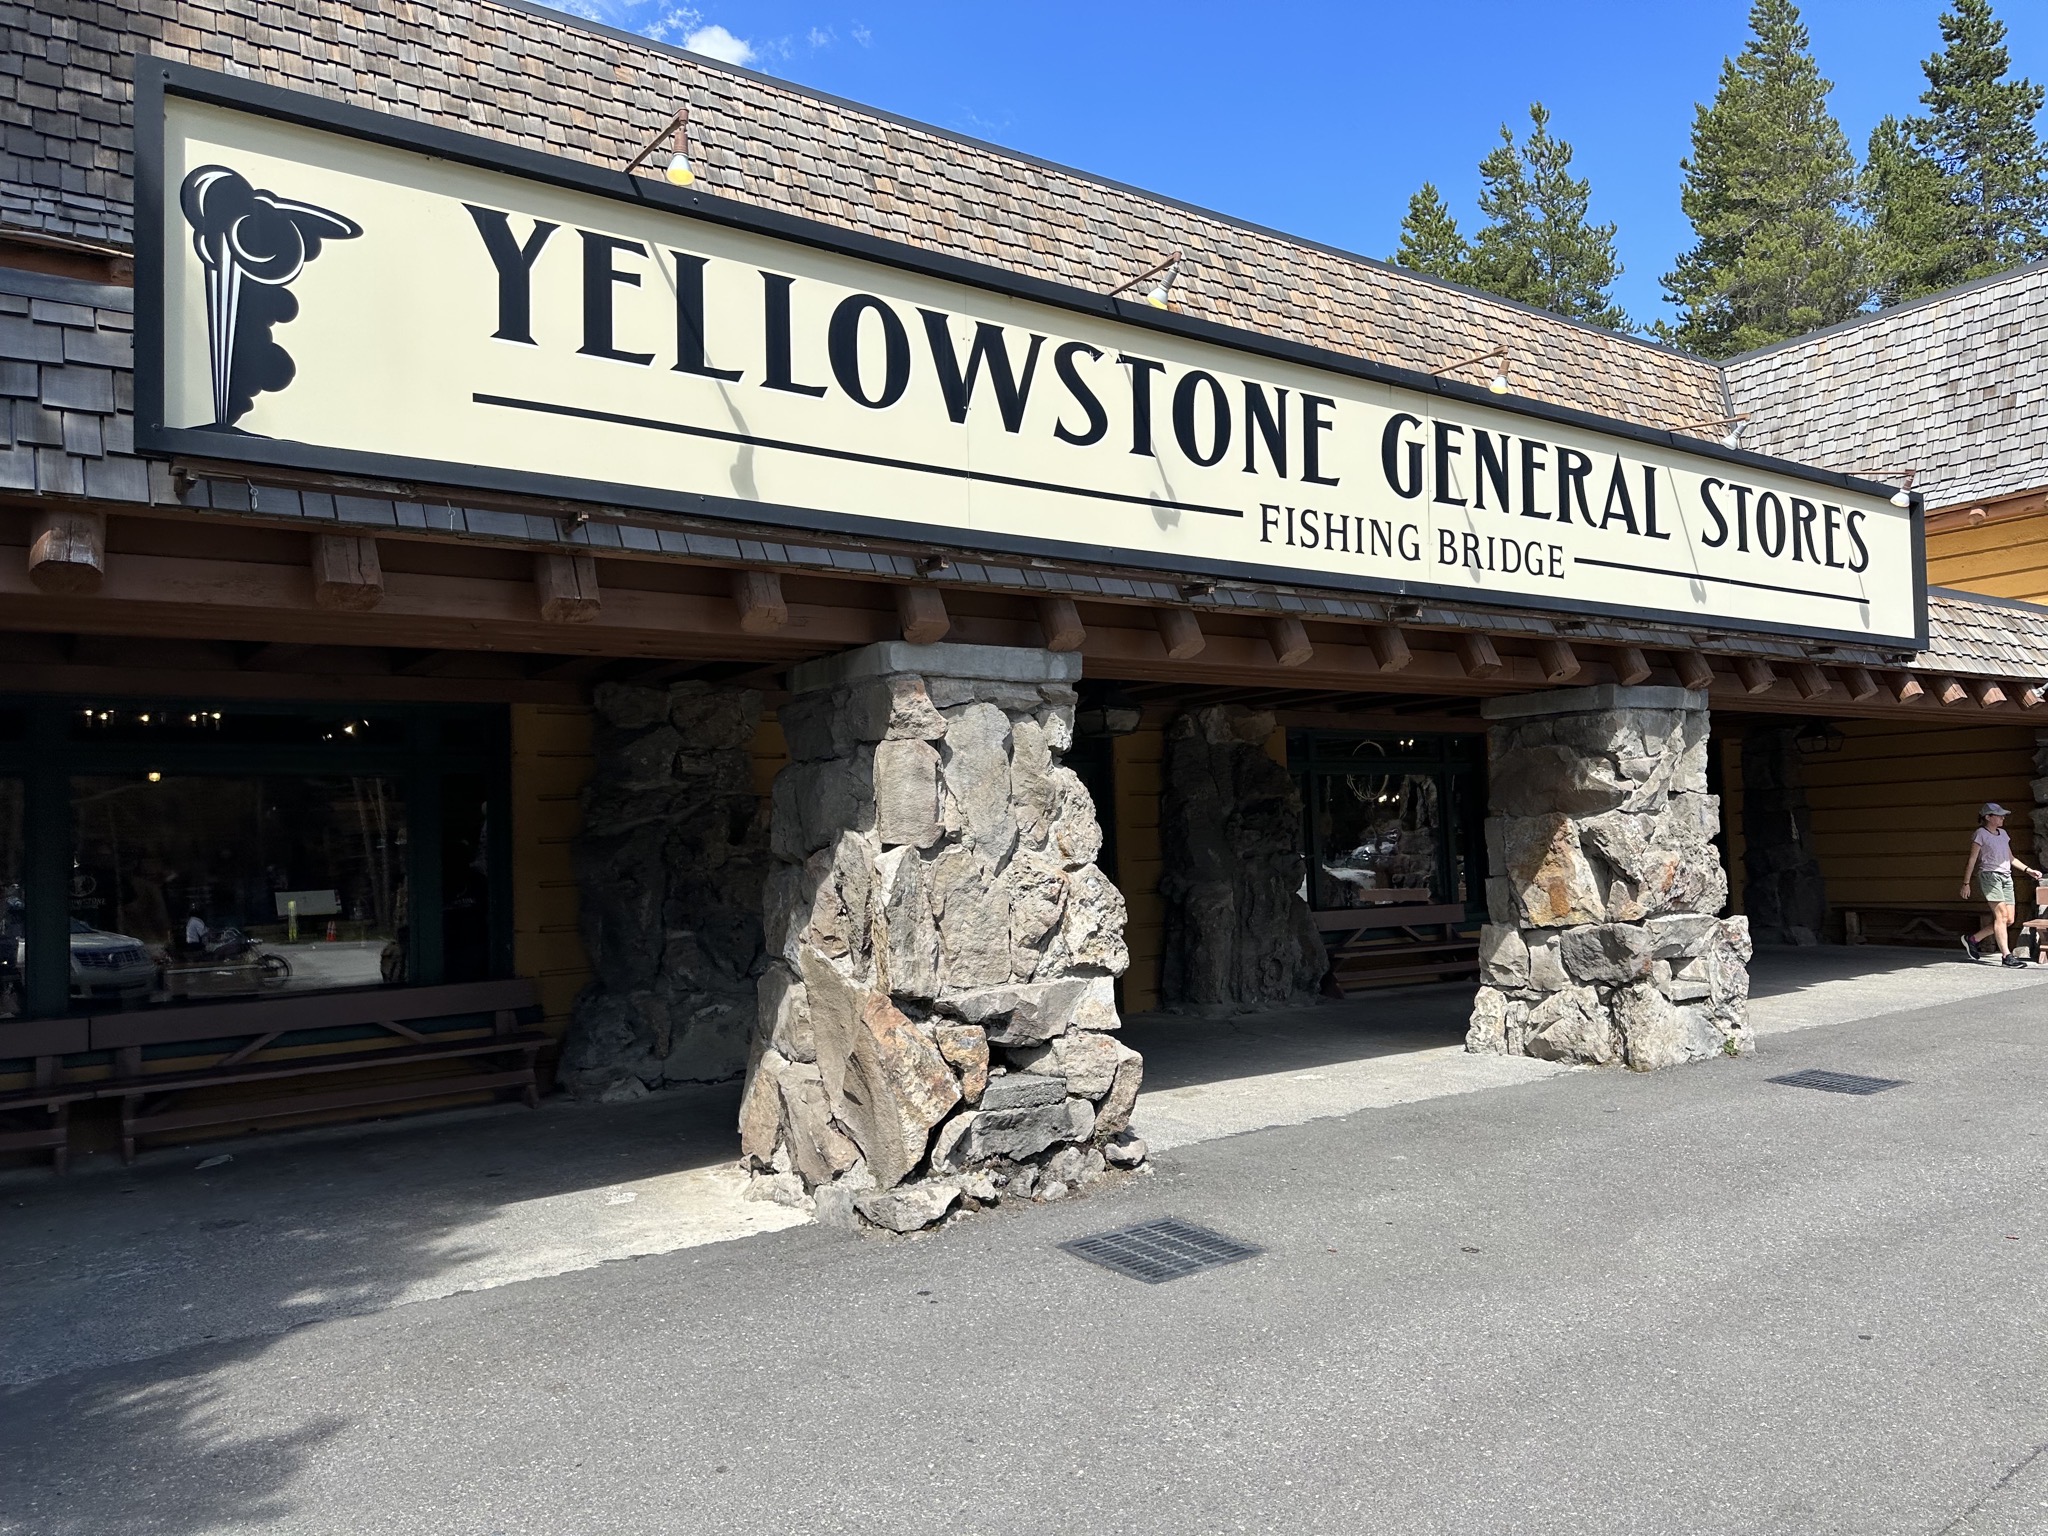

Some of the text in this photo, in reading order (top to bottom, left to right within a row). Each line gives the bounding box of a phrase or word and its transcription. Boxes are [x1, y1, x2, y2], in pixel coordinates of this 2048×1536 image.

[461, 202, 1870, 575] YELLOWSTONE GENERAL STORES
[1259, 503, 1565, 579] FISHING BRIDGE
